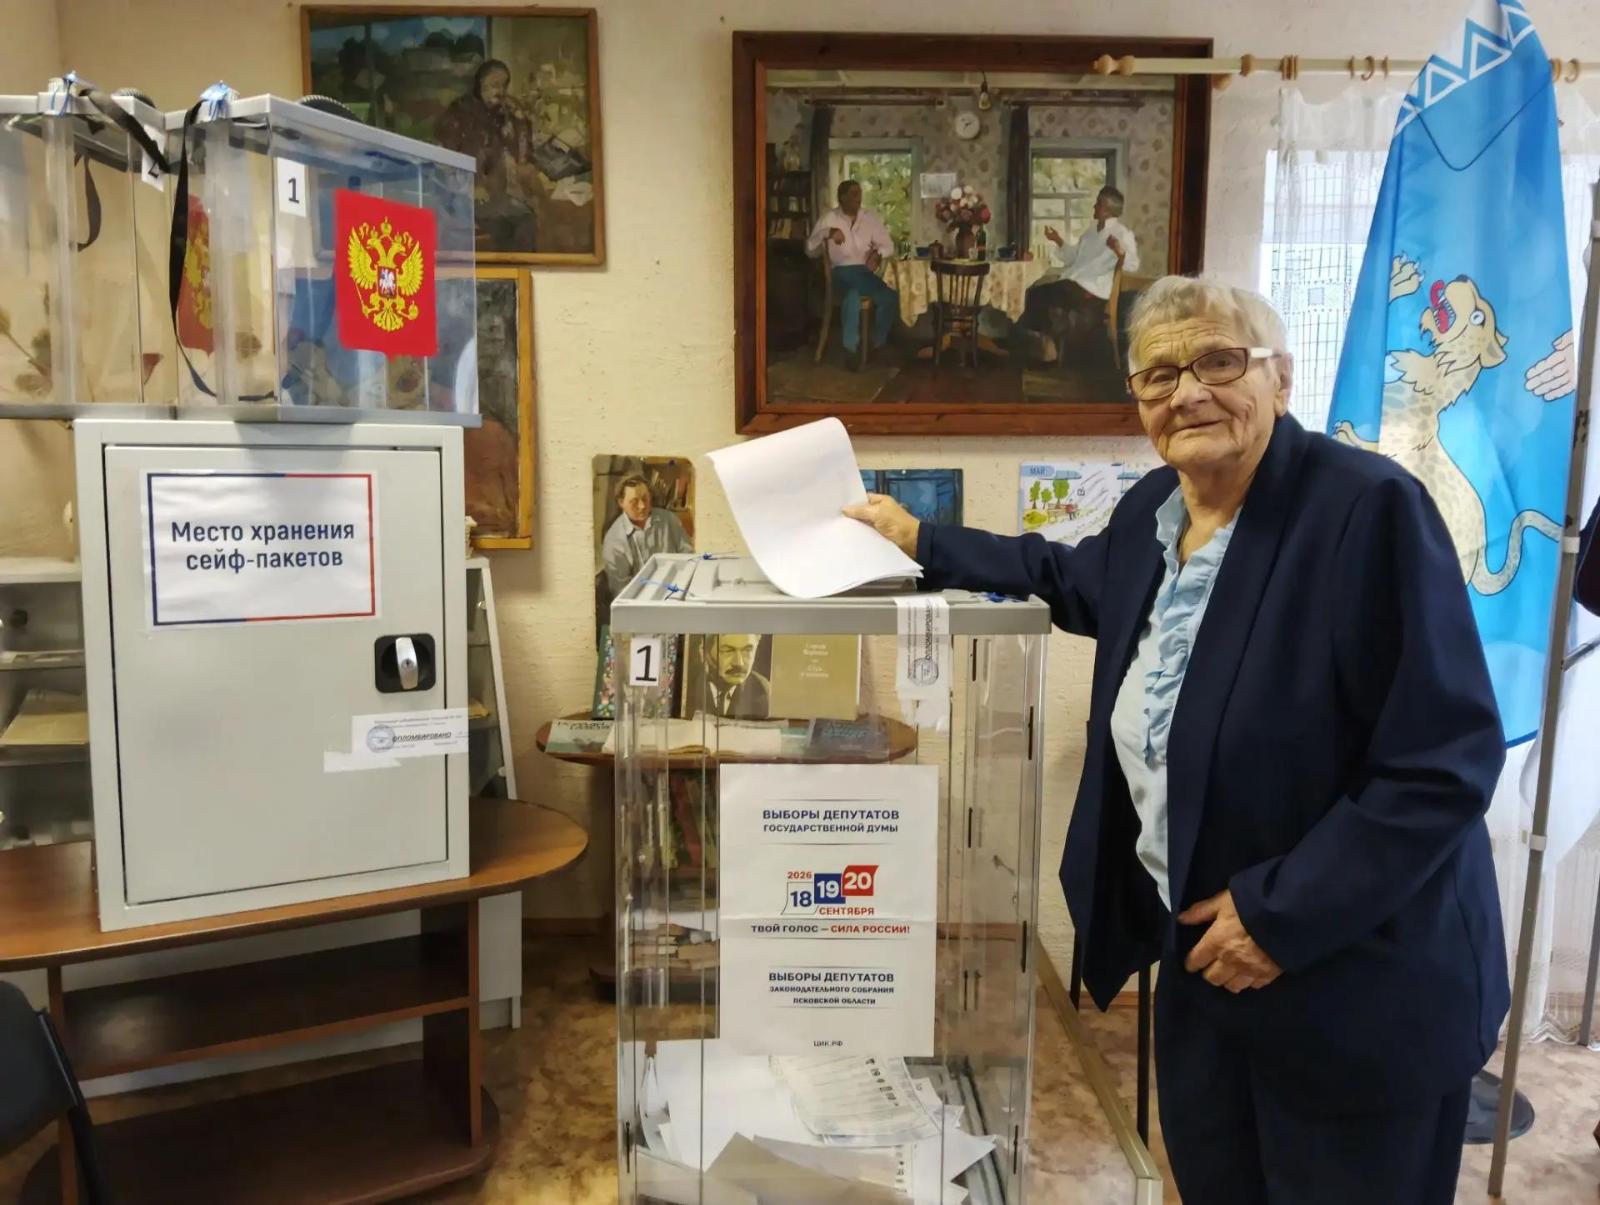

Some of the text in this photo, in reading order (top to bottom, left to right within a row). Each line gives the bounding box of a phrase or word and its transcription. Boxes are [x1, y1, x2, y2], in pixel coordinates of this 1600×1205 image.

[288, 177, 300, 204] 1
[171, 521, 354, 545] Место хранения
[186, 548, 343, 574] сейф-пакетов
[635, 644, 657, 682] 1
[763, 810, 900, 820] ВЫБОРЫ ДЕПУТАТОВ
[763, 823, 898, 833] ГОСУДАРСТВЕННОЙ ДУМЫ
[787, 871, 812, 880] 2026
[790, 872, 872, 908] 18 19 20
[819, 907, 875, 916] СЕНТЯБРЯ
[751, 924, 780, 934] ТВОЙ
[782, 925, 819, 934] ГОЛОС
[830, 925, 860, 934] СИЛА
[862, 925, 911, 935] РОССИИ!
[769, 972, 895, 983] ВЫБОРЫ ДЕПУТАТОВ
[769, 986, 895, 994] ЗАКОНОДАТЕЛЬНОГО СОБРАНИЯ
[793, 996, 876, 1005] ПСКОВСКОЙ ОБЛАСТИ
[813, 1040, 843, 1048] ЦИК.РФ
